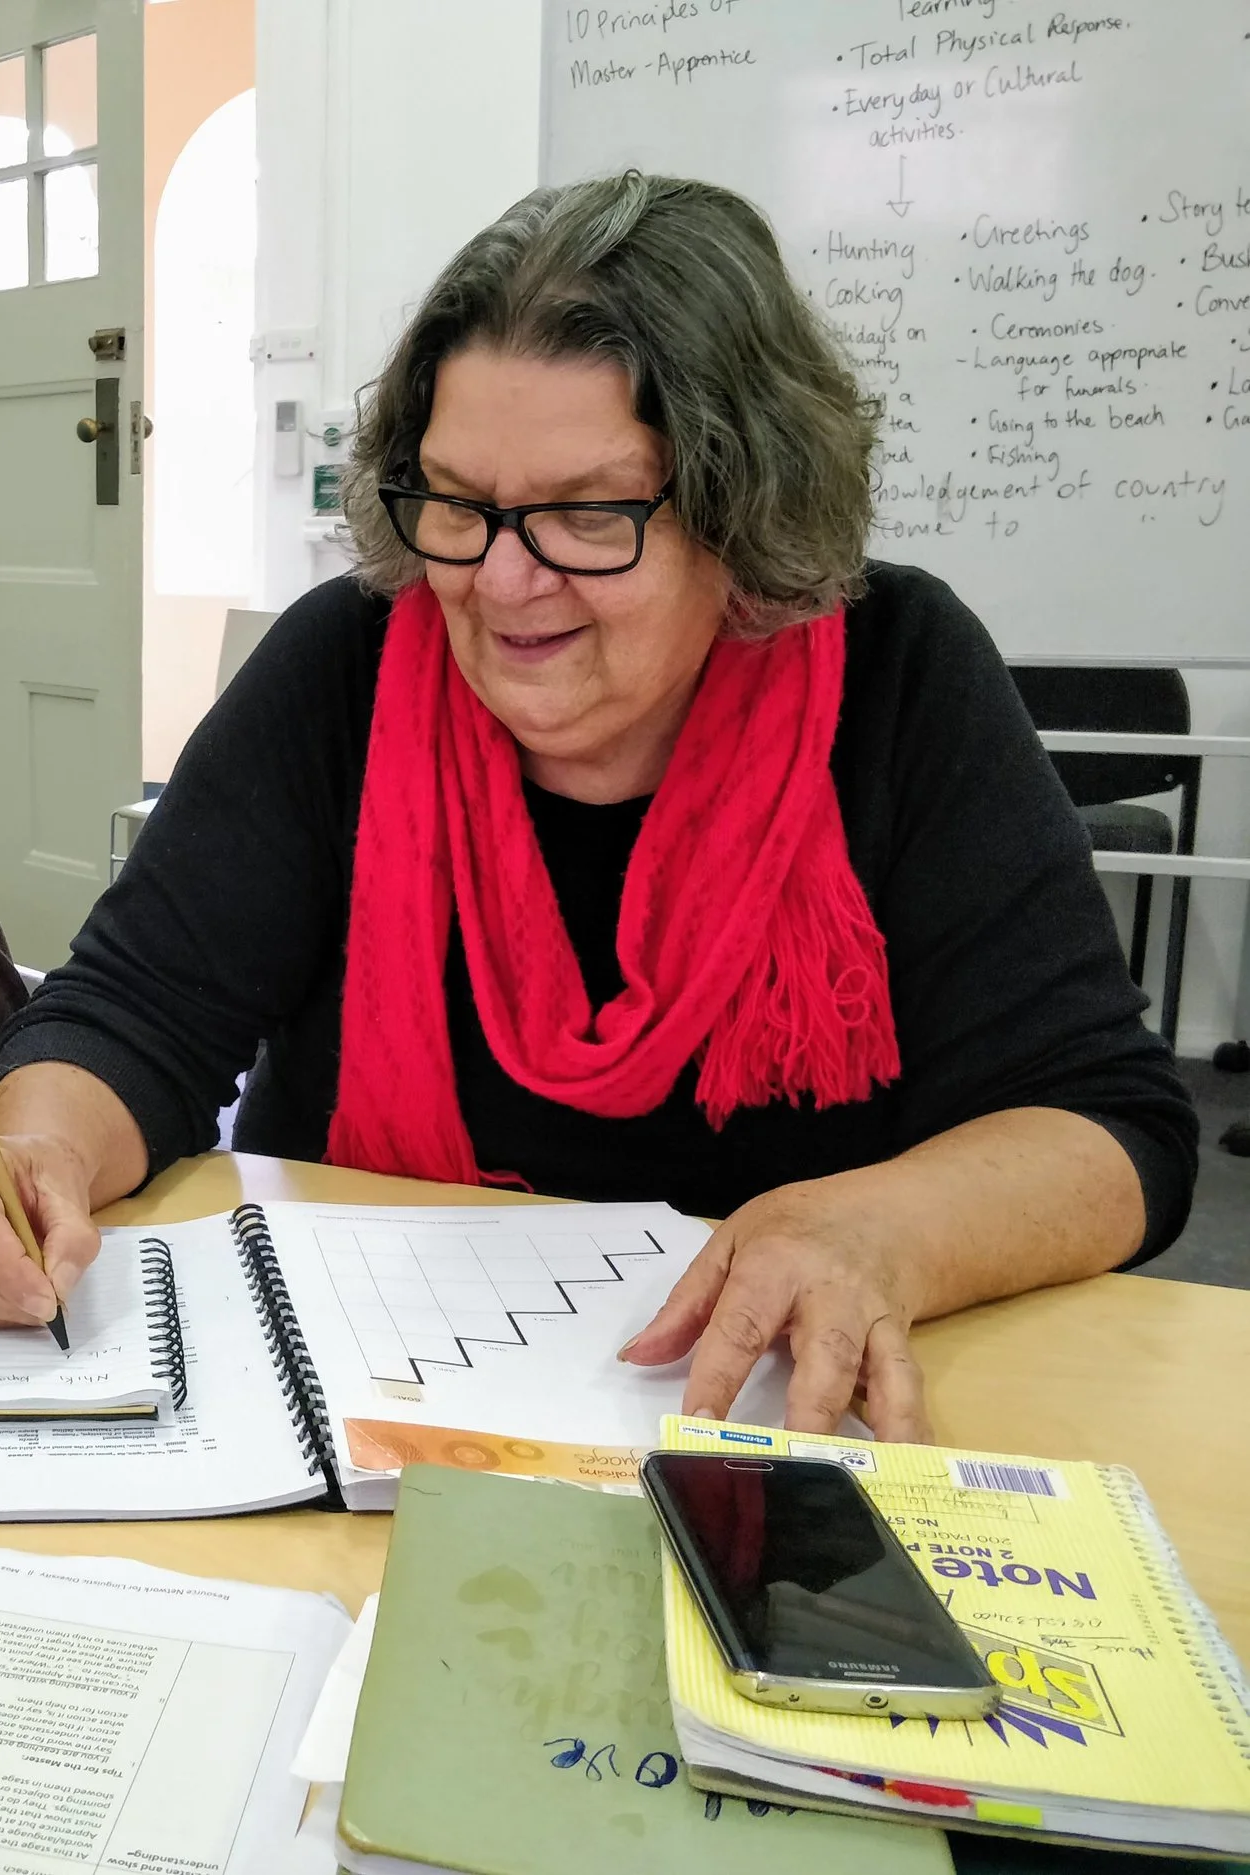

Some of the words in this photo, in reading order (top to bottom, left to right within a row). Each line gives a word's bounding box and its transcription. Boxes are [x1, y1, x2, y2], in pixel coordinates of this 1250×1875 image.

[567, 9, 590, 43] 10
[597, 0, 699, 39] Principles
[850, 35, 917, 70] Total
[936, 23, 1035, 62] Physical
[954, 80, 977, 99] or
[984, 60, 1083, 98] Cultural
[1159, 190, 1224, 236] Story
[974, 213, 1090, 255] Greetings
[828, 230, 915, 280] Hunting
[969, 264, 1058, 302] Walking
[1071, 259, 1095, 287] the
[826, 278, 903, 332] Cooking
[907, 328, 927, 342] on
[974, 346, 1074, 375] Language
[1088, 341, 1188, 372] appropriate
[1017, 376, 1049, 401] for
[1066, 376, 1137, 398] funerals
[900, 392, 915, 406] a
[889, 415, 921, 433] tea
[988, 409, 1035, 447] Going
[1044, 411, 1058, 429] to
[1065, 409, 1096, 428] the
[1108, 405, 1165, 429] beach
[987, 445, 1060, 482] Fishing
[878, 471, 1041, 522] nowledgement
[1057, 469, 1093, 499] of
[1116, 470, 1227, 527] country
[985, 511, 1019, 540] to
[574, 1448, 641, 1467] guages
[579, 1467, 638, 1479] talising
[911, 1516, 940, 1528] No.
[916, 1529, 971, 1542] PAGES
[976, 1534, 1012, 1546] 200
[926, 1543, 992, 1559] NOTE
[997, 1549, 1014, 1560] 2
[82, 1578, 126, 1590] Linguistic
[127, 1584, 141, 1592] for
[931, 1557, 1098, 1602] Note
[143, 1586, 184, 1595] Network
[185, 1589, 230, 1600] Resource
[828, 1661, 901, 1674] SAMSUNG
[101, 1767, 122, 1778] Tips
